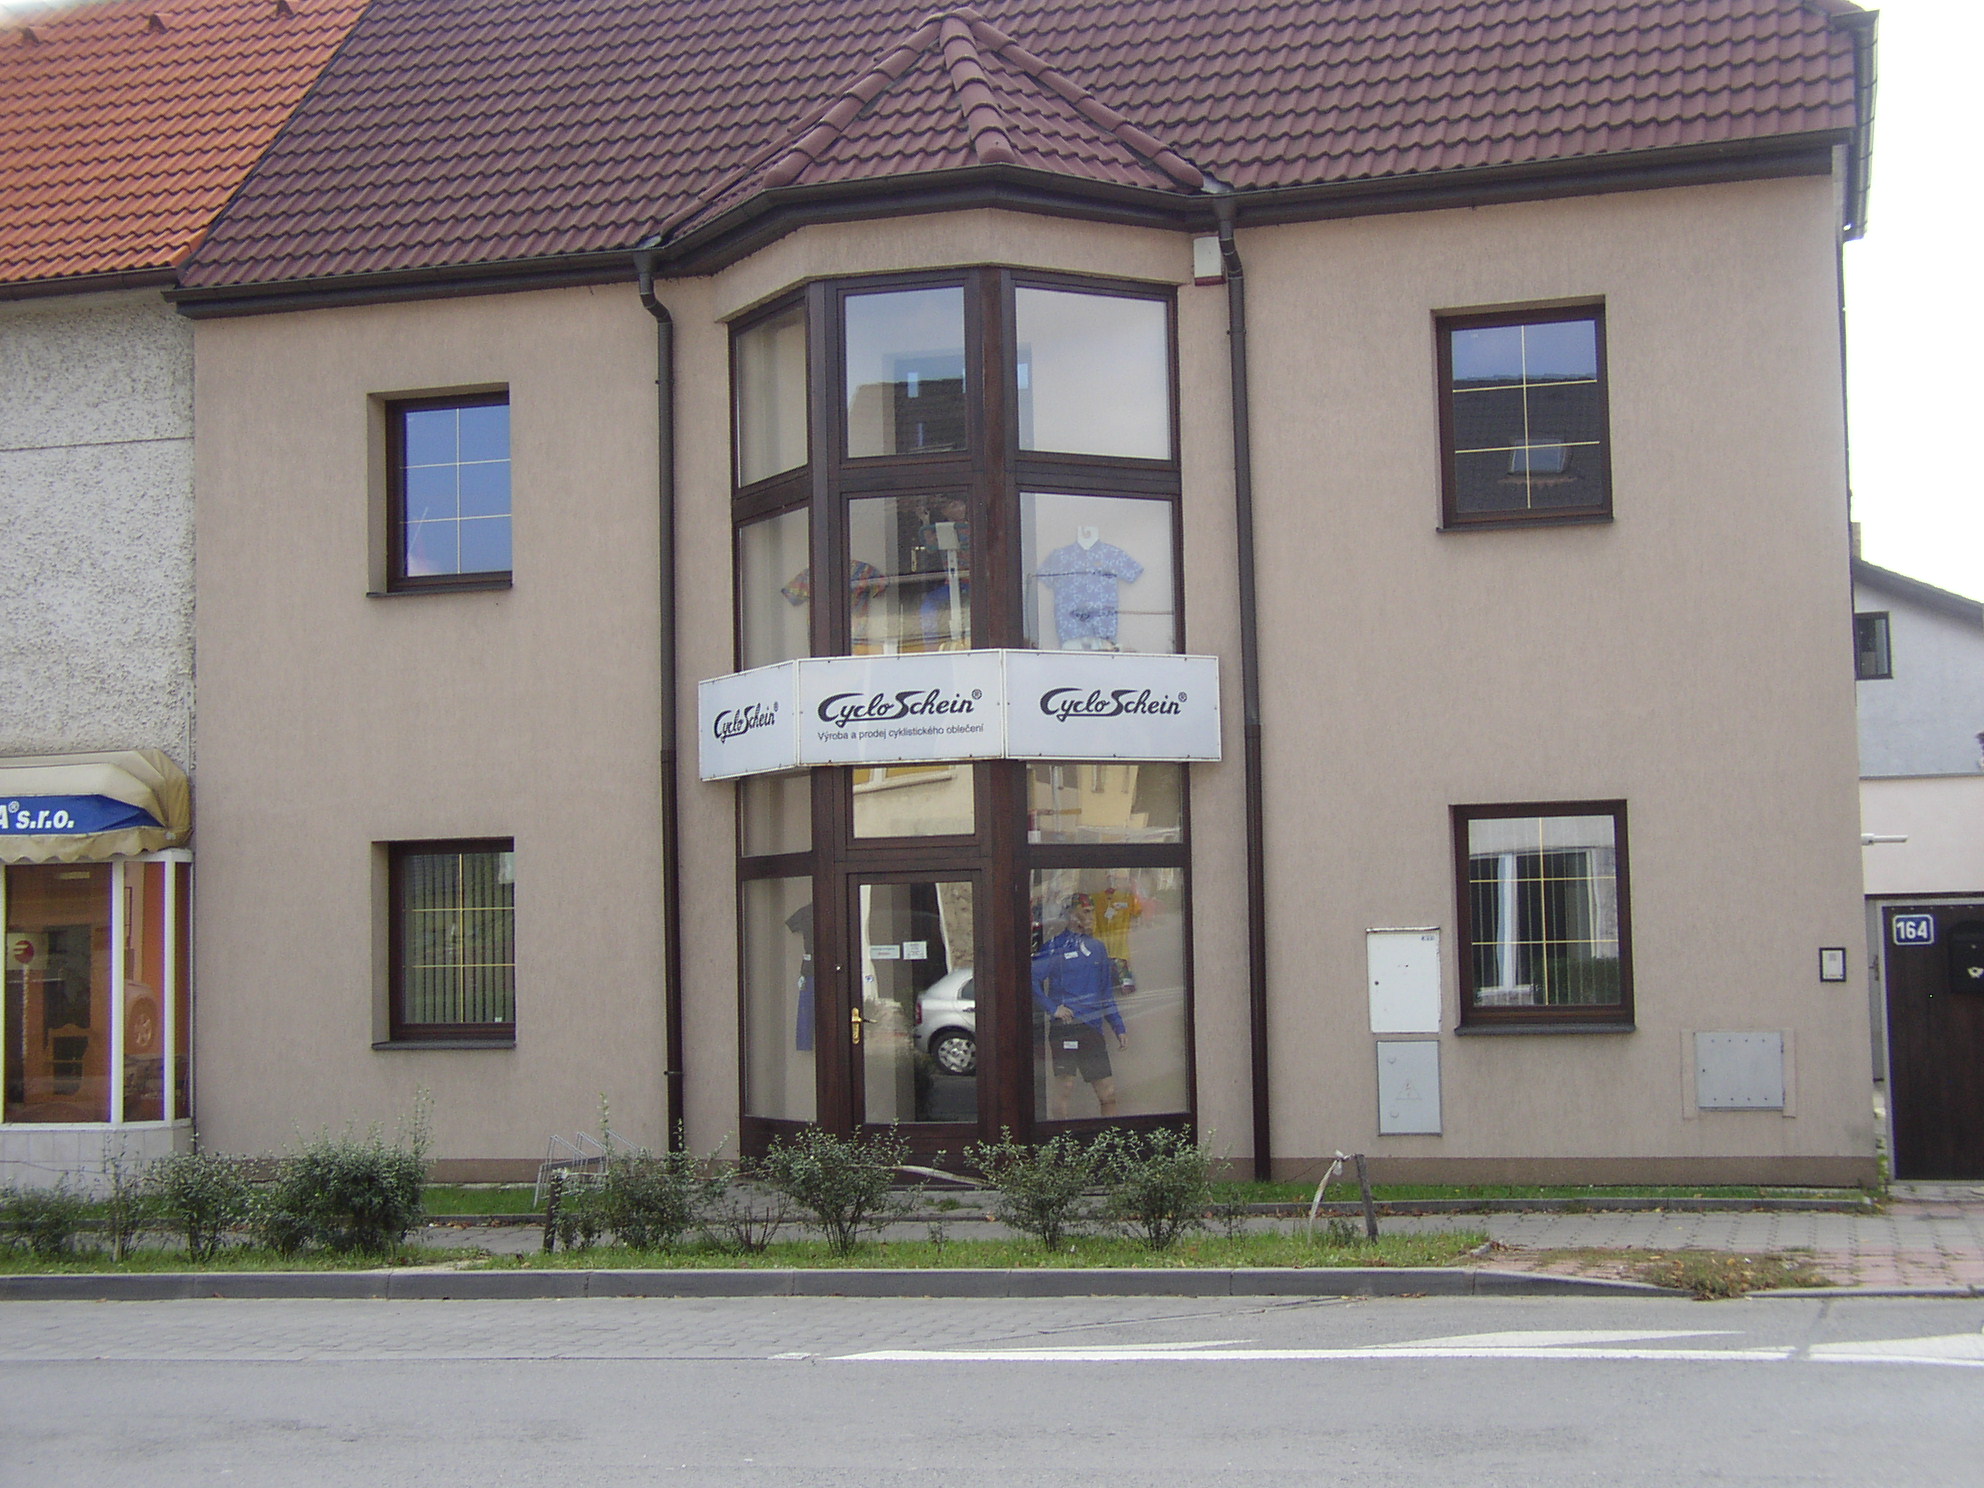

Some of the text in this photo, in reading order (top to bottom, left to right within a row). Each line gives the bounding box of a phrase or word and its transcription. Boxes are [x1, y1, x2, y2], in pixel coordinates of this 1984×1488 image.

[817, 732, 849, 743] Výroba
[858, 728, 887, 741] prodej
[889, 725, 945, 740] cyklistického
[946, 723, 984, 735] oblečení
[1897, 920, 1928, 940] 164
